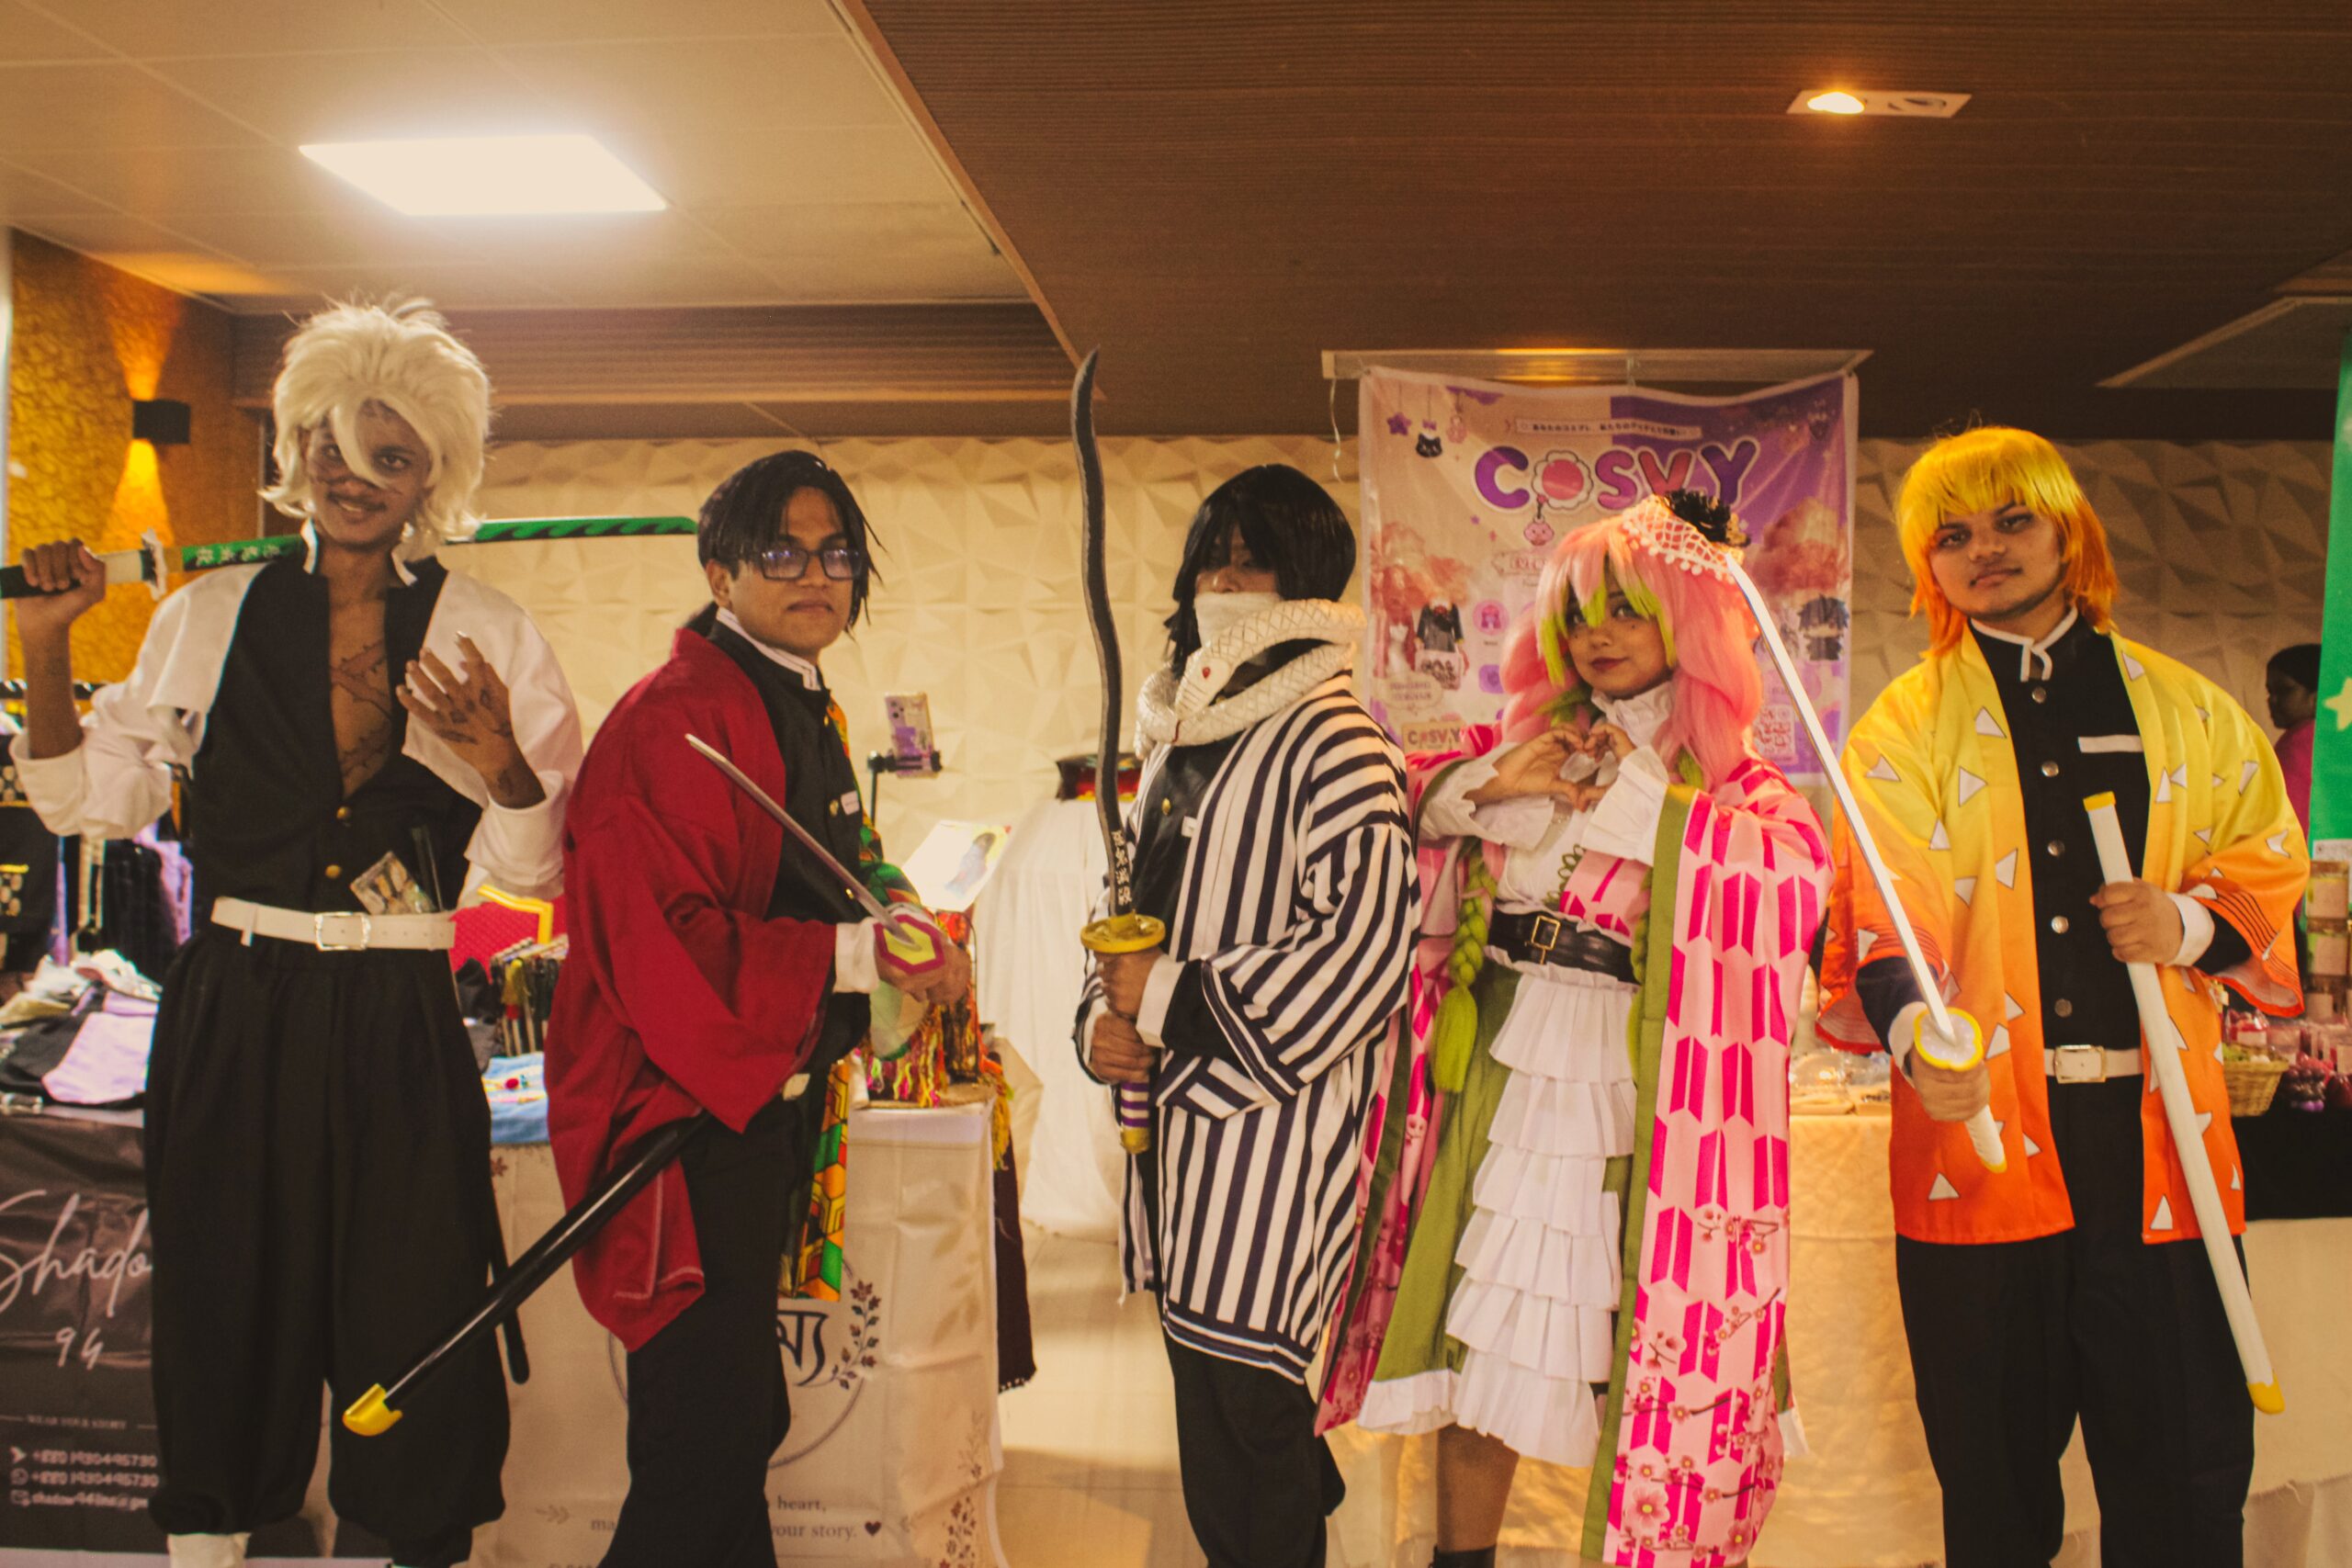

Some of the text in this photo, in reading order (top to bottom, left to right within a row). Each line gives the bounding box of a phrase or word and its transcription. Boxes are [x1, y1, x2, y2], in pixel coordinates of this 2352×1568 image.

[1473, 438, 1759, 511] COSVY
[0, 1190, 153, 1317] Shado
[777, 1495, 826, 1512] heart,
[810, 1525, 856, 1542] story.
